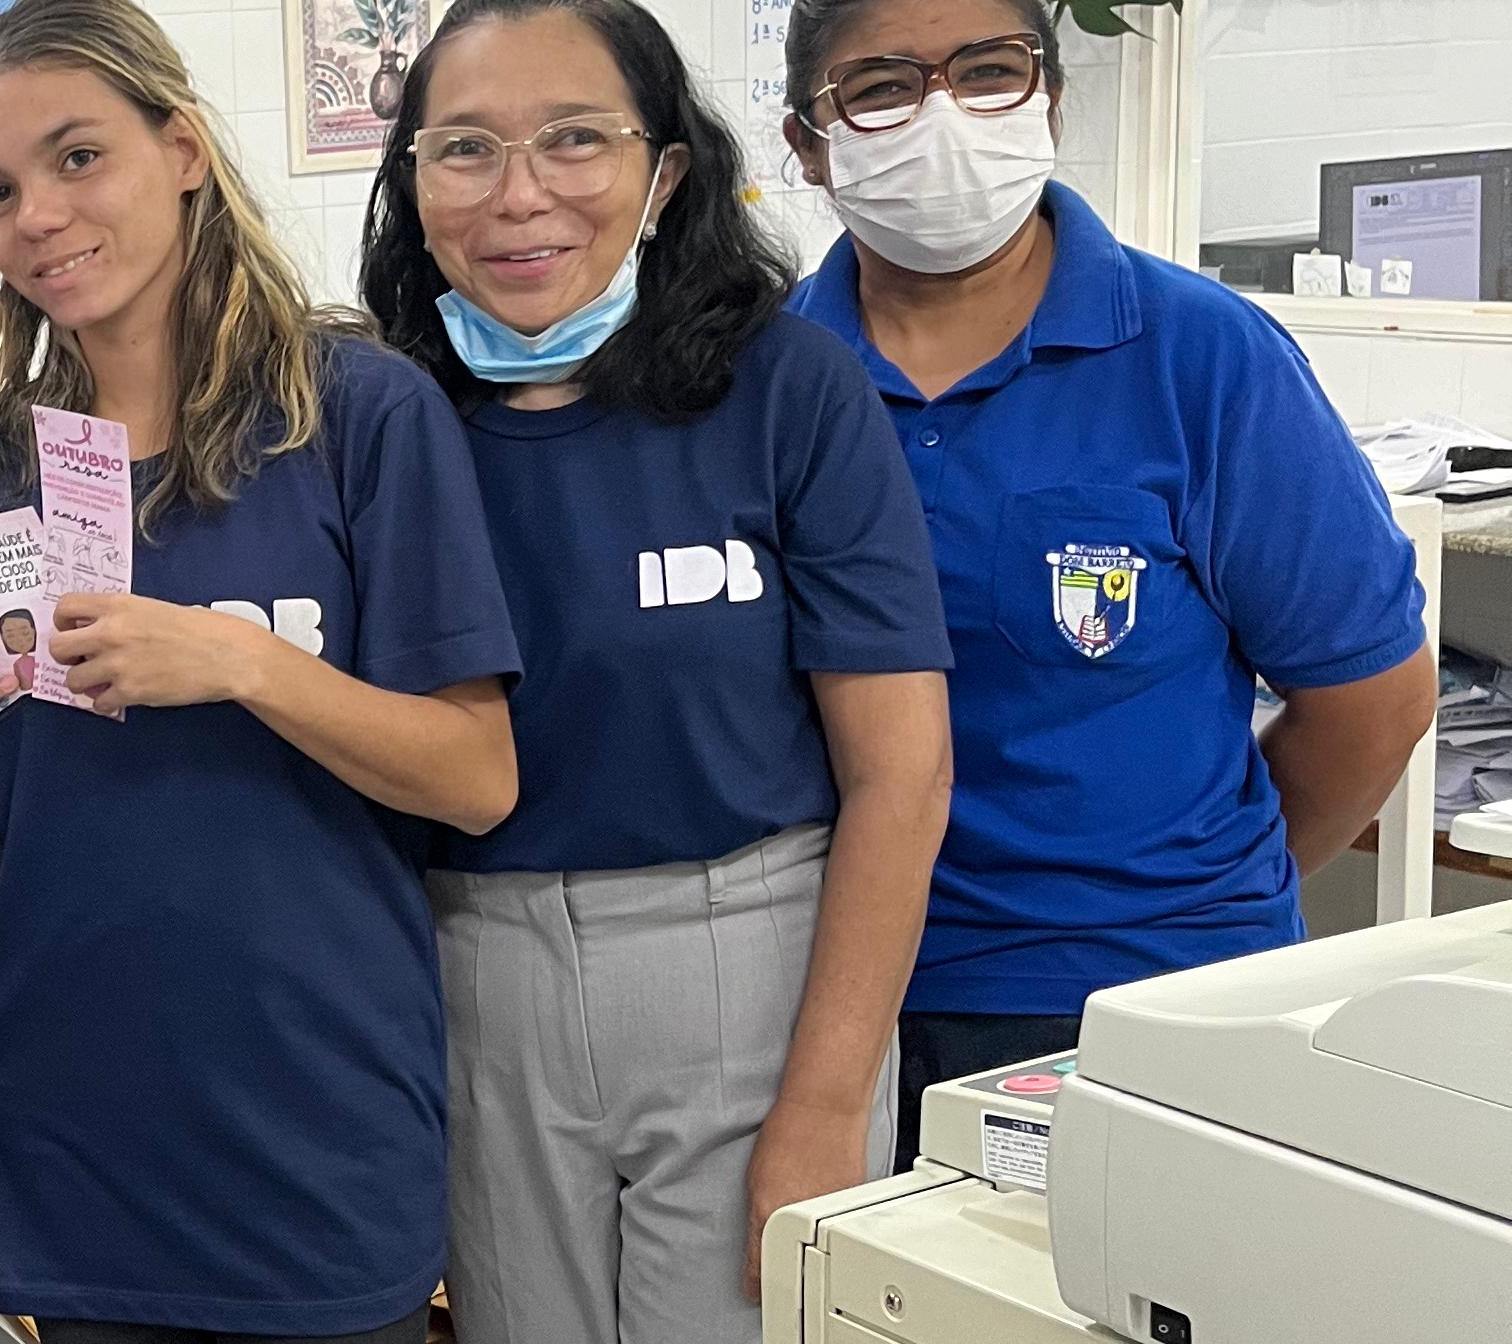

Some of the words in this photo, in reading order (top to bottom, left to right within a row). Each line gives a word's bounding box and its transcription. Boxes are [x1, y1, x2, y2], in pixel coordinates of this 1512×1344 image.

[42, 442, 123, 472] OUTUBRO
[15, 543, 43, 559] MAIS
[639, 539, 765, 608] IDB
